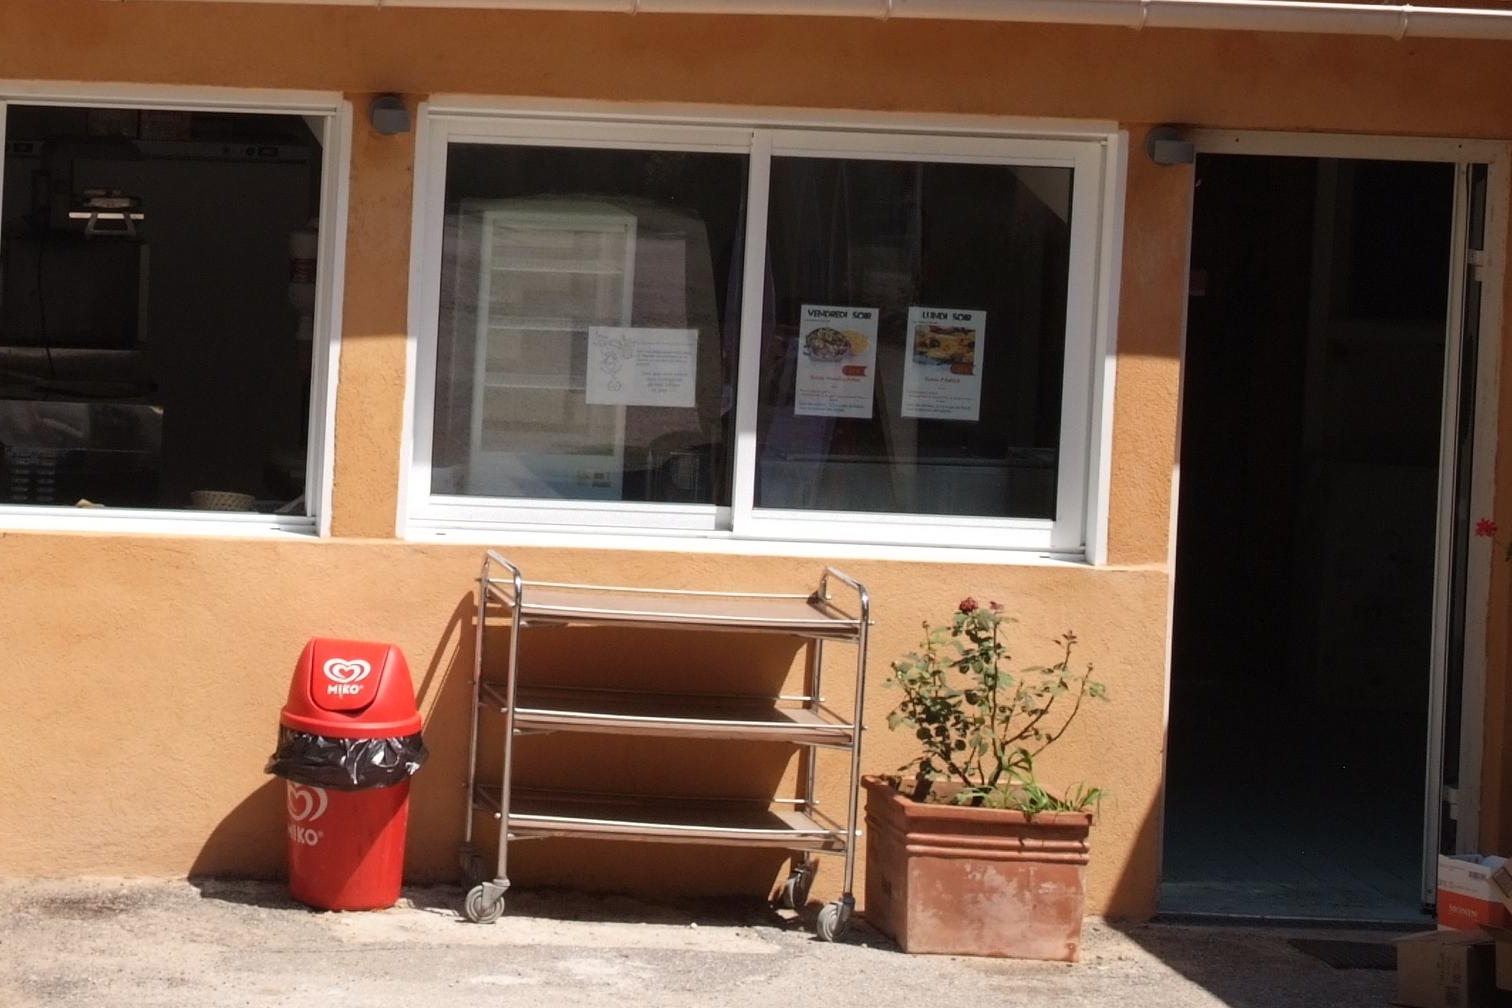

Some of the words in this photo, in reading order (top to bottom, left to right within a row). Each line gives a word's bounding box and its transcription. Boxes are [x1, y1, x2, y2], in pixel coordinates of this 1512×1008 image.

[807, 309, 848, 319] VENDREDI
[852, 311, 872, 320] SOIR
[922, 311, 948, 320] LUNDI
[952, 313, 972, 321] SOIR
[327, 684, 360, 695] MIKO
